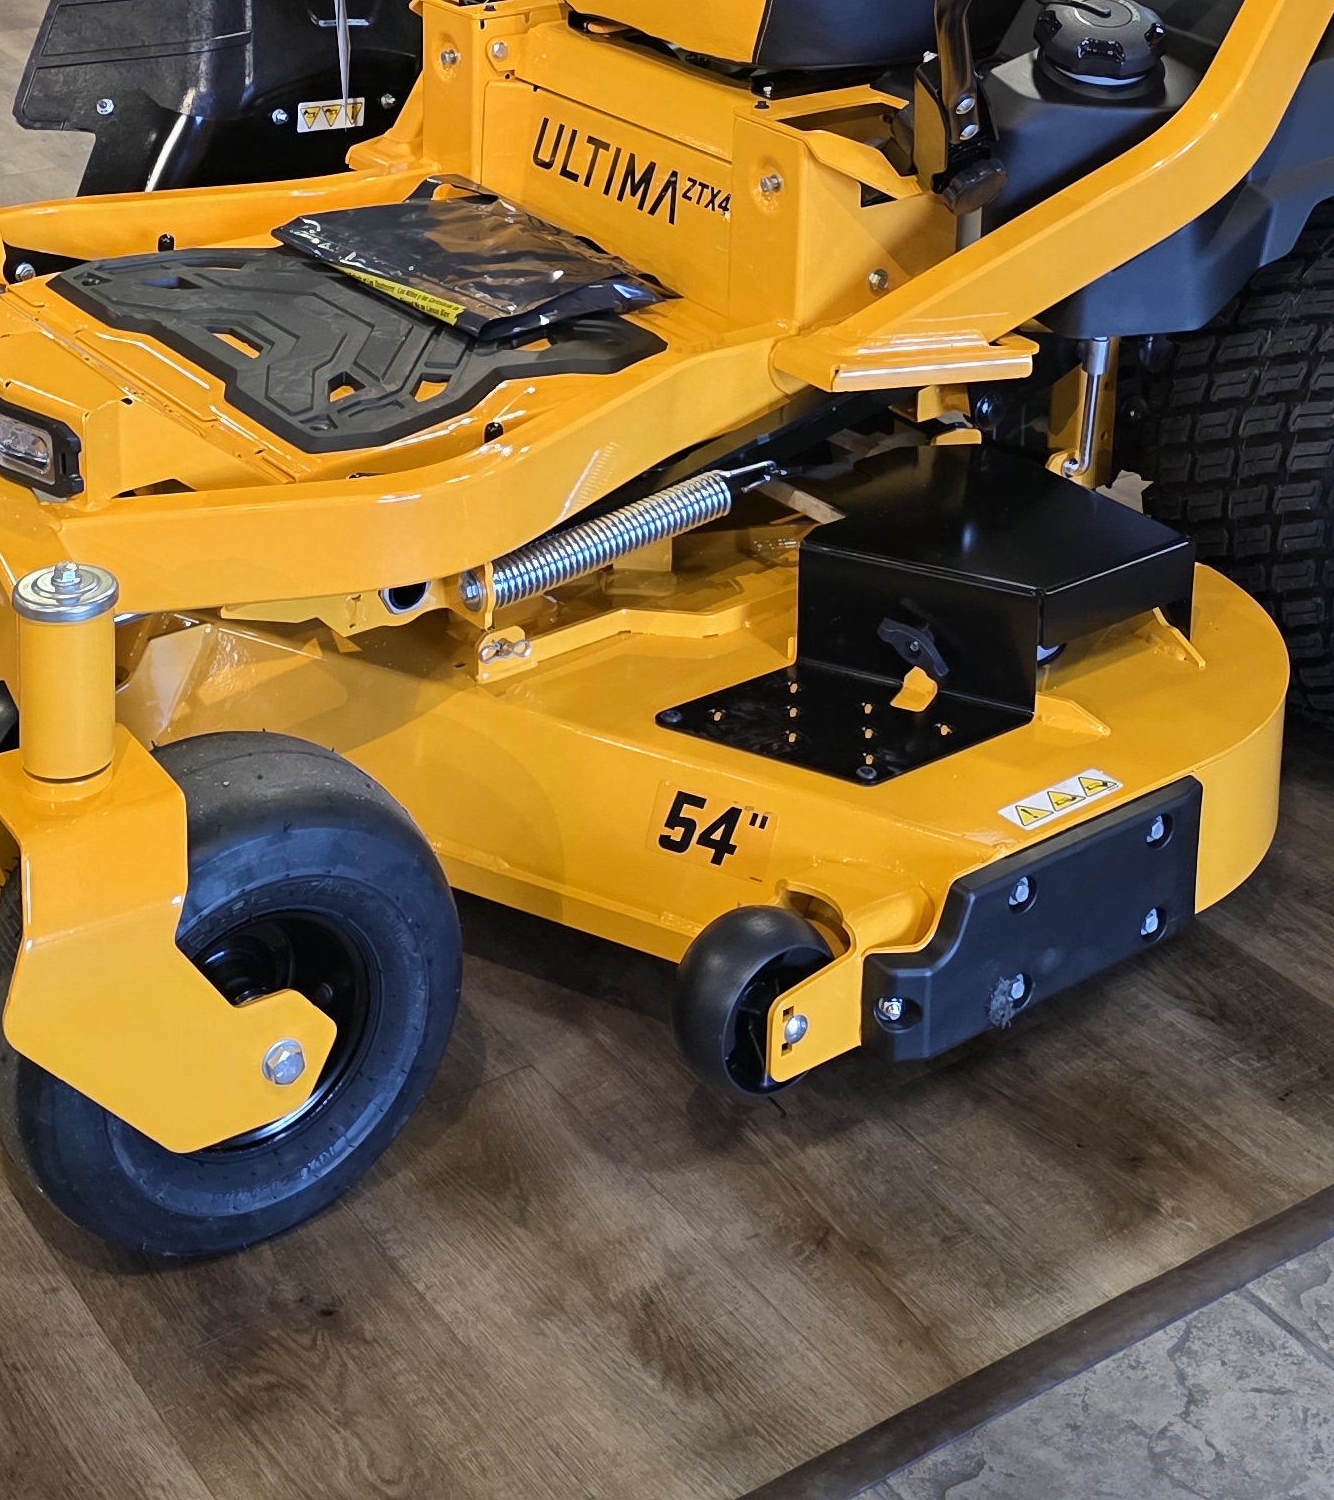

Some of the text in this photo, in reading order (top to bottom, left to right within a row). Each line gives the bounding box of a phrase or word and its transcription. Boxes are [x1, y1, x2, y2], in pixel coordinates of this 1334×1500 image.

[532, 117, 732, 225] ULTIMA ZTX4
[658, 790, 769, 866] 54"
